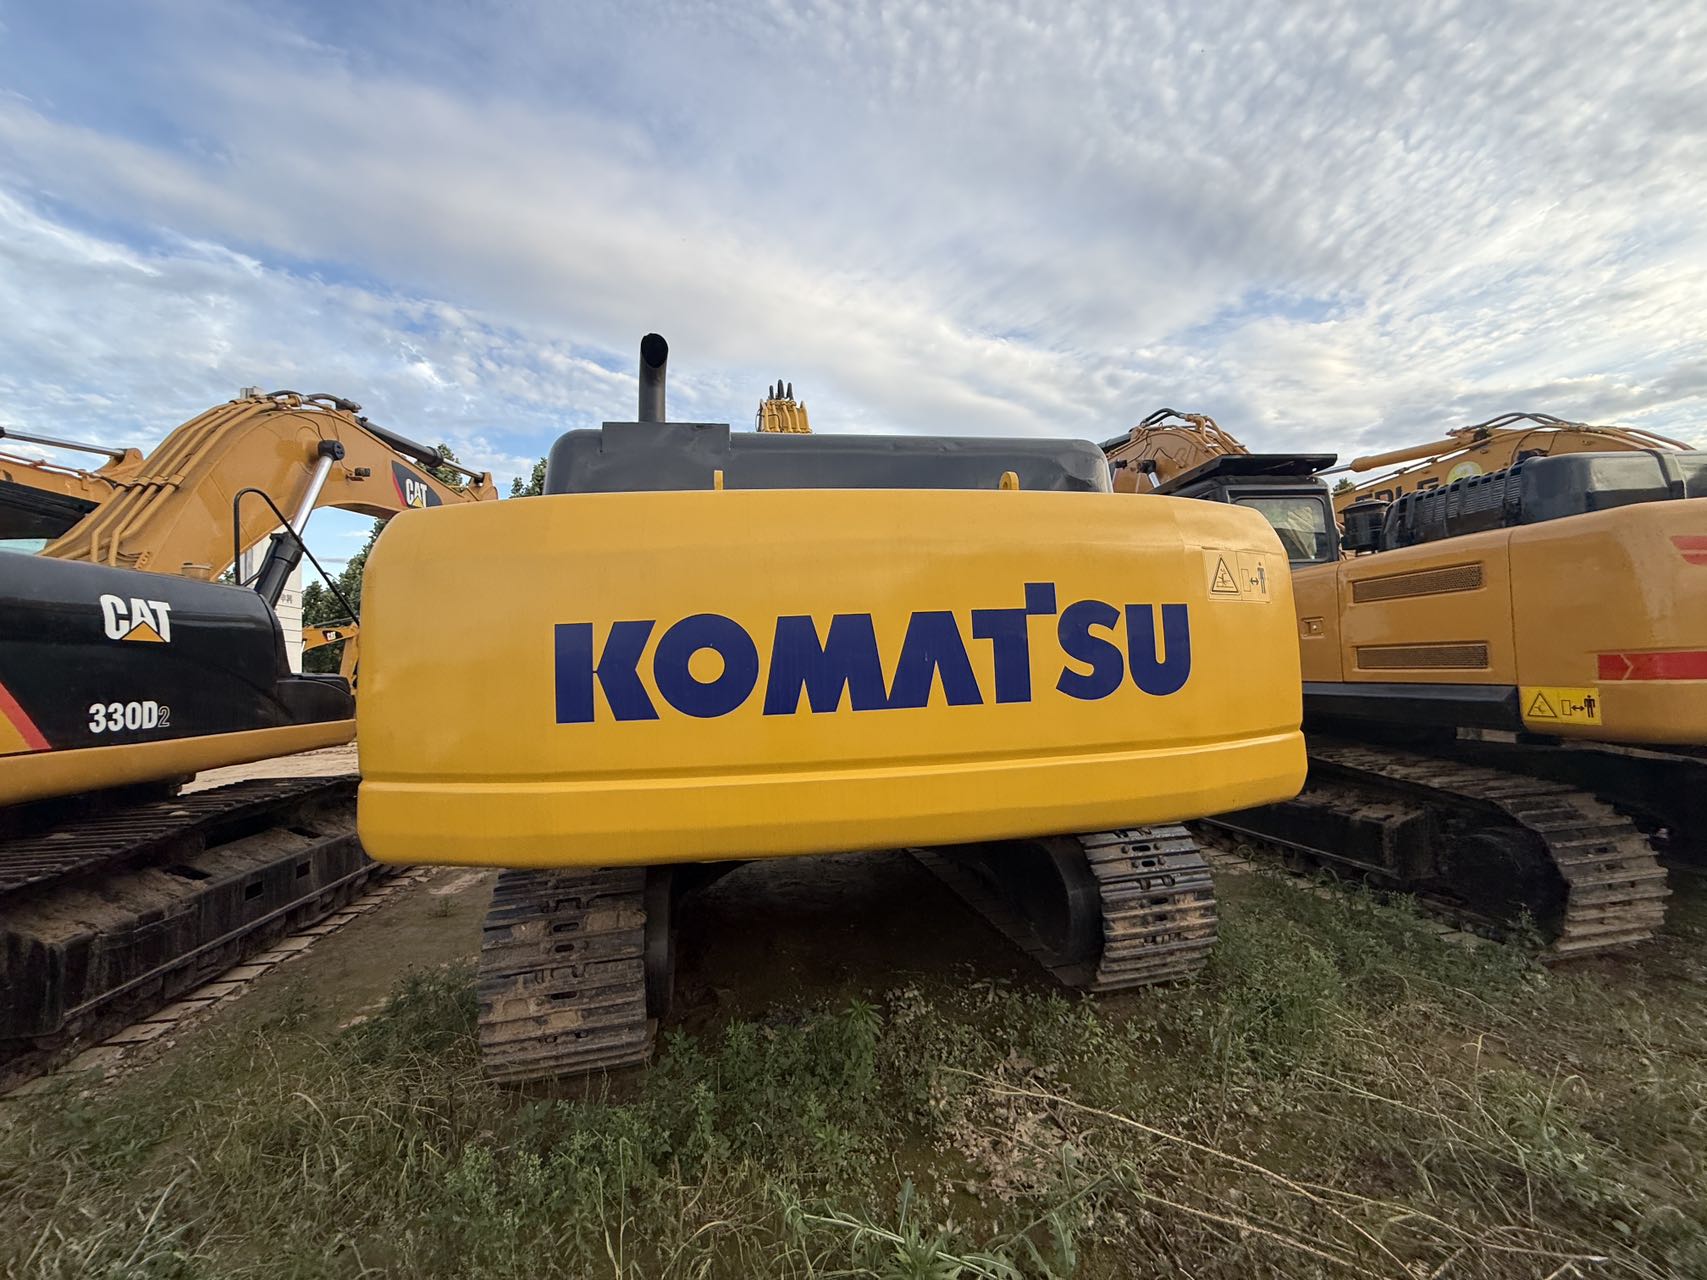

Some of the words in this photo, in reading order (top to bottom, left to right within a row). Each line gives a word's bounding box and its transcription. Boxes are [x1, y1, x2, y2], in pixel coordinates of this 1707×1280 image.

[405, 478, 428, 508] CAT
[99, 594, 172, 643] CAT
[554, 582, 1192, 724] KOMATSU
